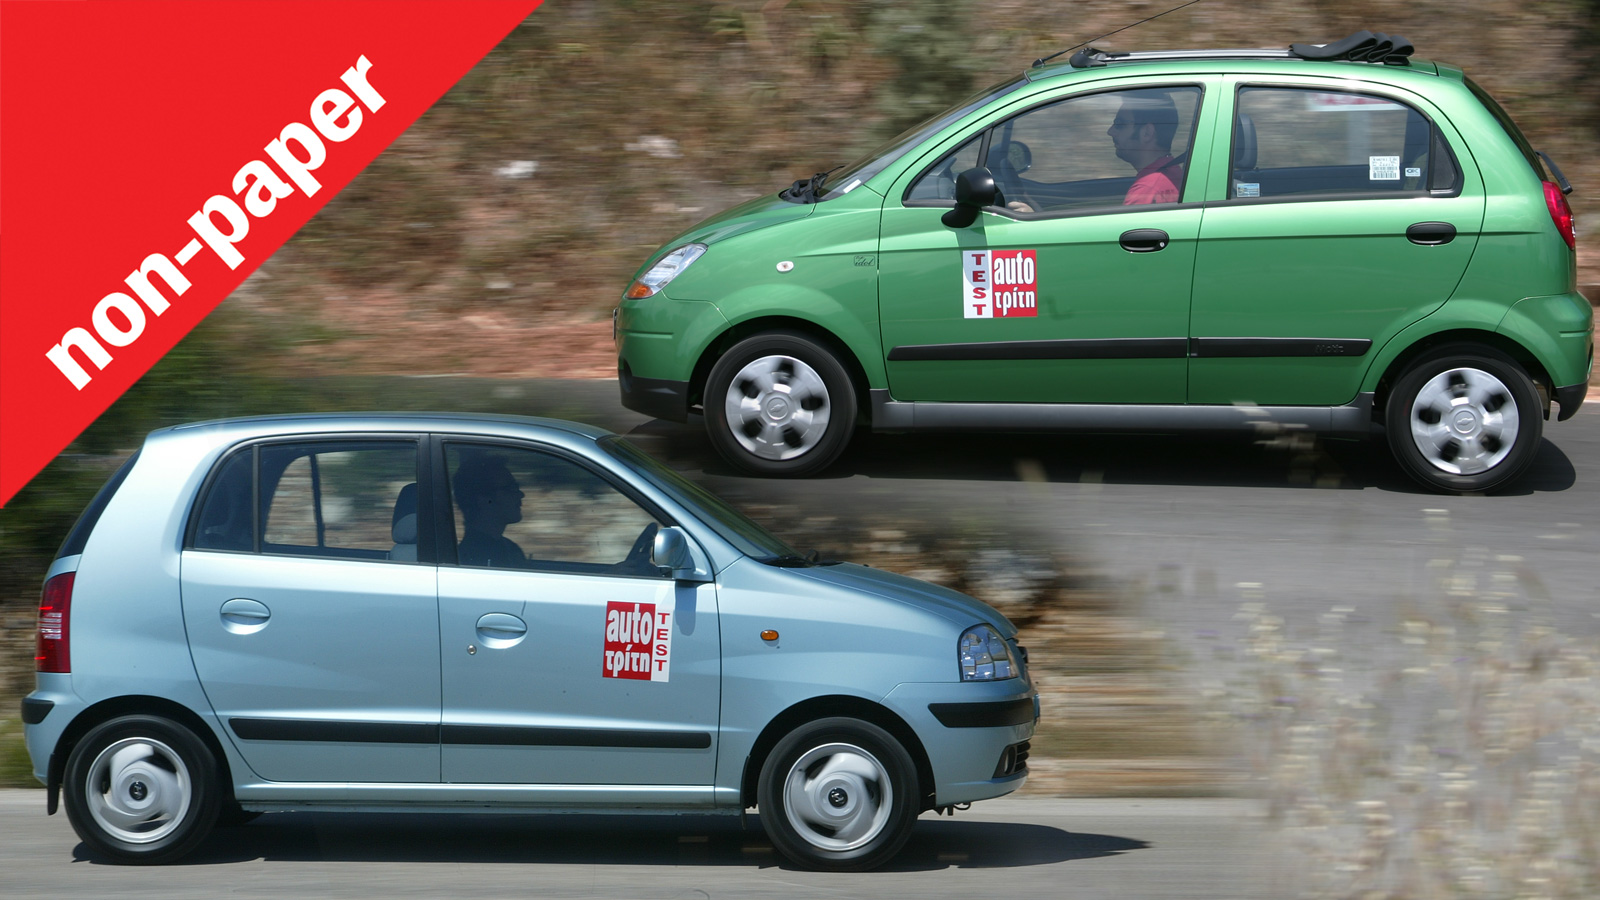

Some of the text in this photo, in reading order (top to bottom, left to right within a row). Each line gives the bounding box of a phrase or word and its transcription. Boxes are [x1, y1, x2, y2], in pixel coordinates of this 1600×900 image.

[971, 253, 987, 316] TEST
[993, 251, 1035, 285] auto
[994, 286, 1036, 317] τρίτη
[606, 603, 653, 645] auto
[654, 612, 670, 671] TEST
[605, 644, 650, 677] τρίτη
